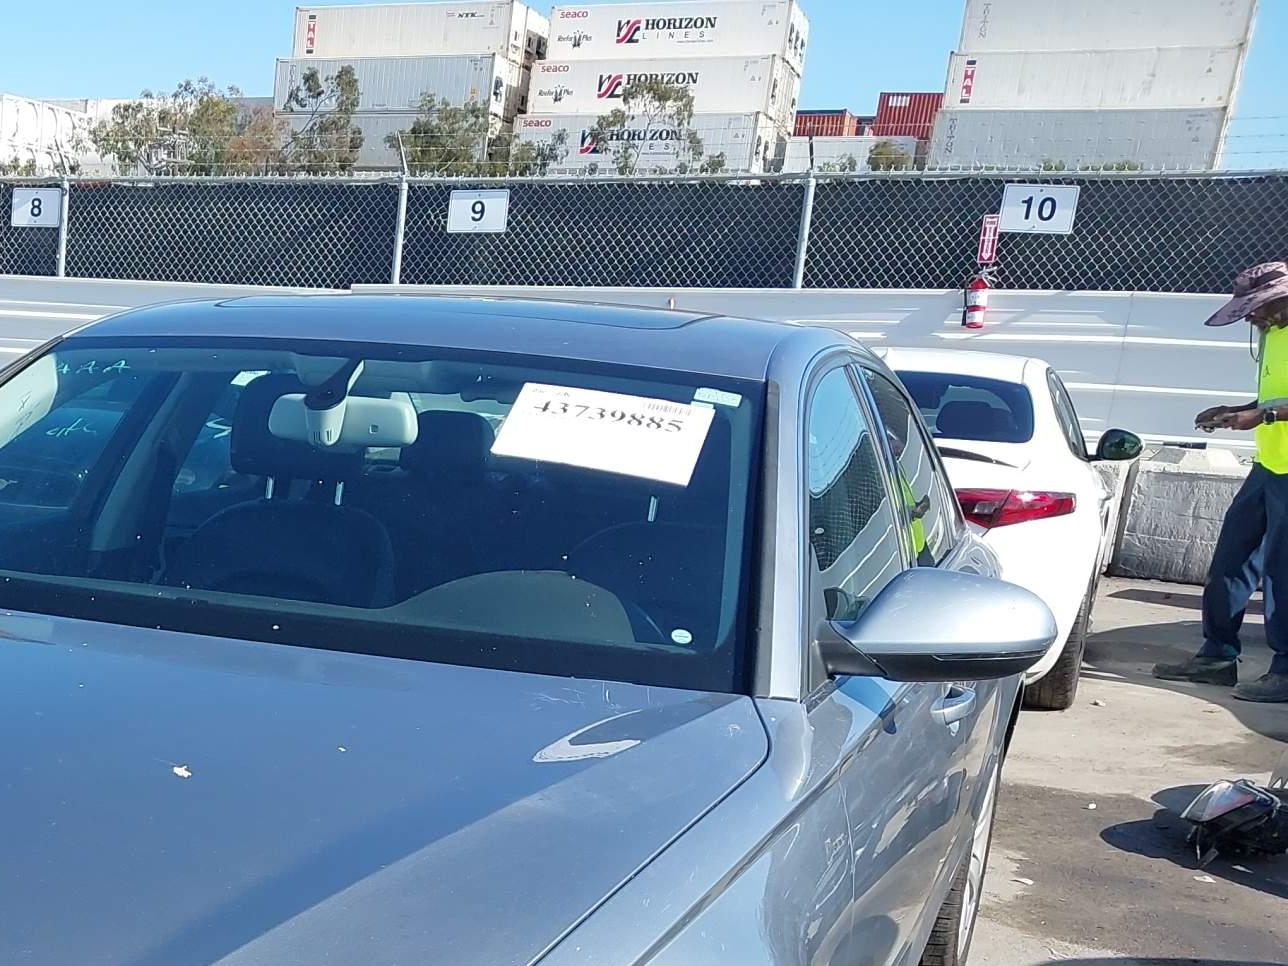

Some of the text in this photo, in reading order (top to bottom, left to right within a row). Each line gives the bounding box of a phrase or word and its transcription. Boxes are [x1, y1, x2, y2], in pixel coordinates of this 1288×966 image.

[559, 9, 589, 19] seaco
[644, 17, 718, 31] HORIZON
[642, 30, 705, 40] LINES
[540, 64, 570, 73] seaco
[626, 72, 699, 85] HORIZON
[961, 67, 975, 97] TAL
[522, 118, 552, 128] seaco
[30, 197, 42, 217] 8
[470, 200, 486, 222] 9
[1021, 196, 1057, 221] 10
[533, 399, 686, 433] 43739885
